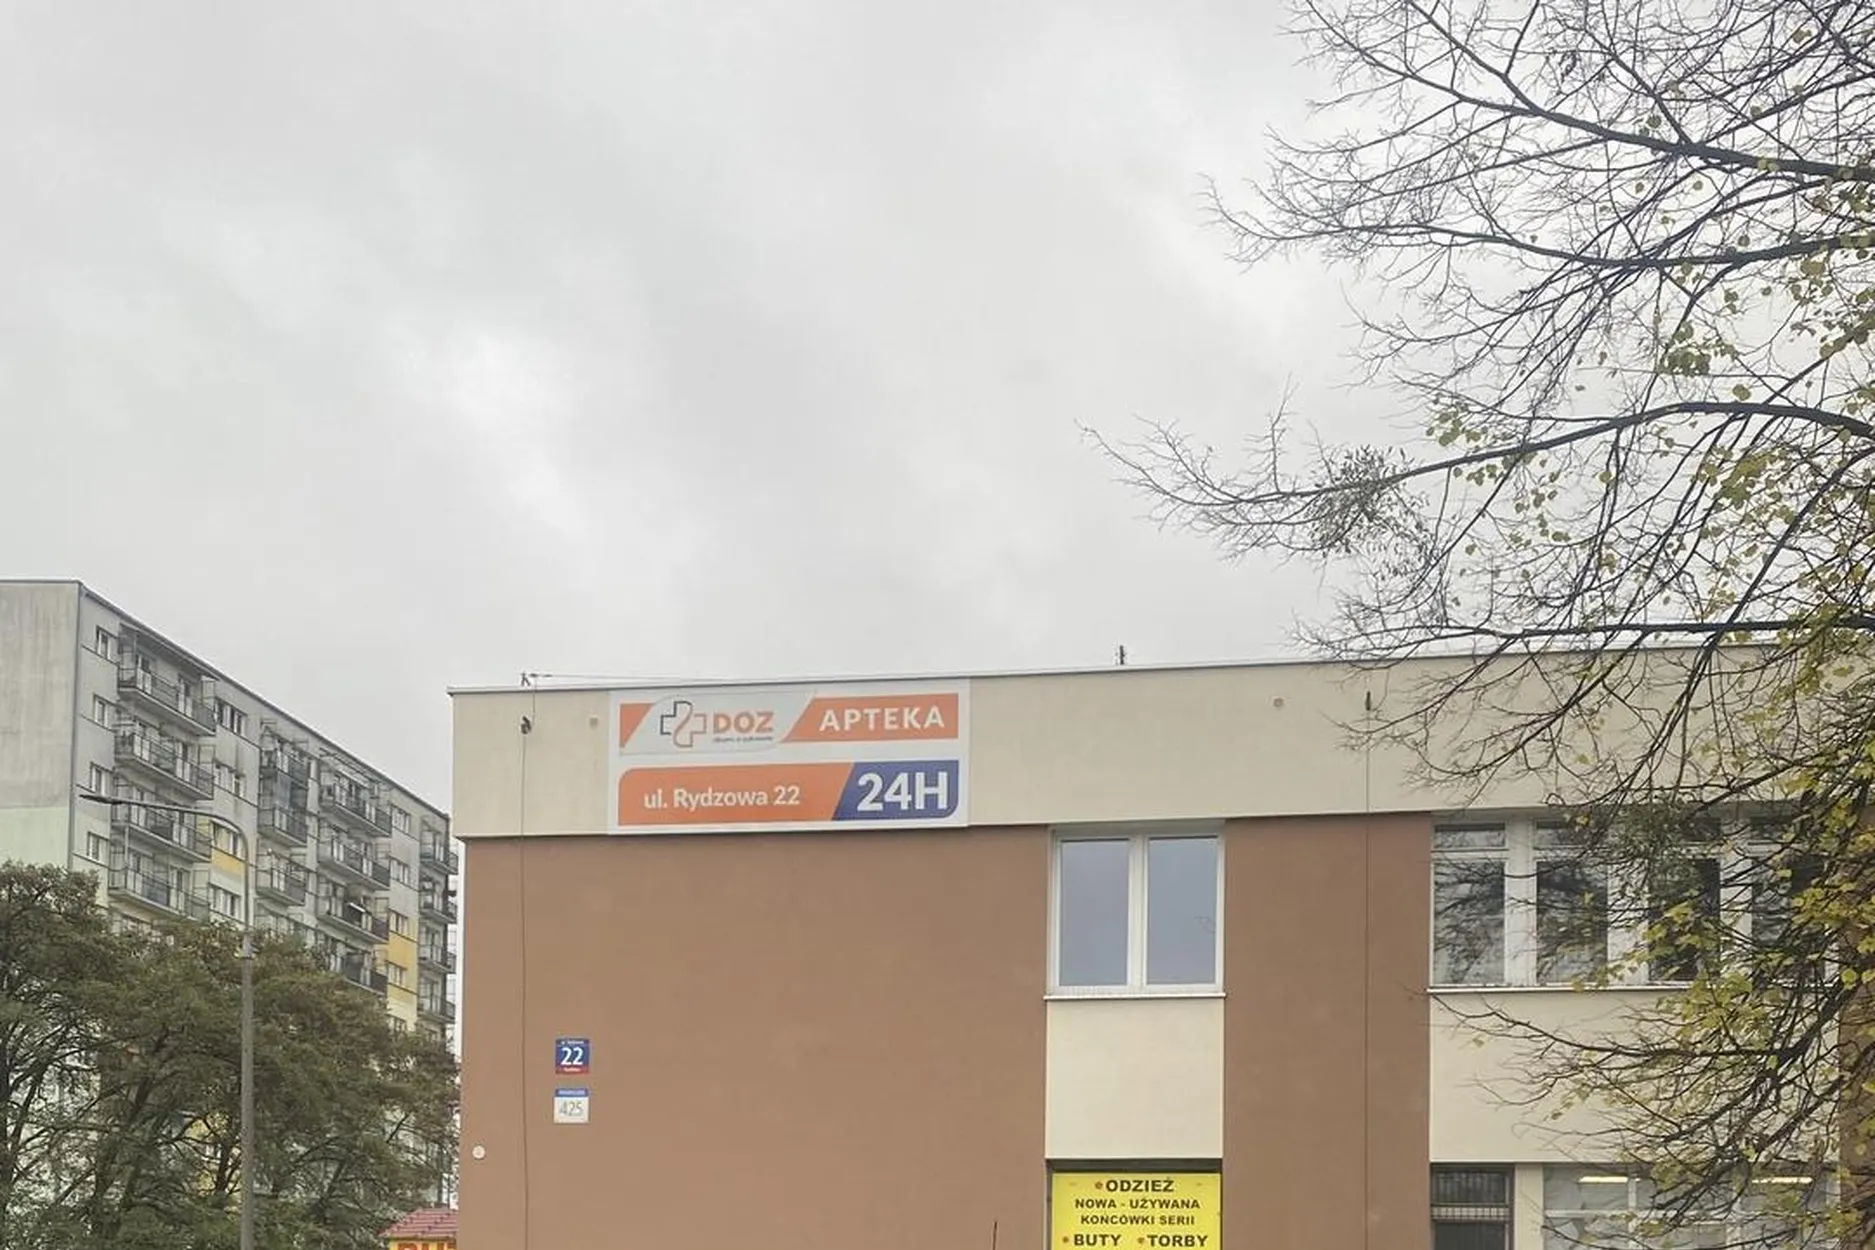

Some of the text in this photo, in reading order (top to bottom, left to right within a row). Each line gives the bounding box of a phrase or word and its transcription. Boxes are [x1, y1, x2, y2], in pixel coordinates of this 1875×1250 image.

[712, 711, 774, 735] DOZ
[819, 705, 945, 732] APTEKA
[644, 785, 800, 813] ul. Rydzowa 22
[856, 771, 948, 812] 24H
[560, 1046, 584, 1066] 22
[558, 1100, 584, 1117] 425
[1074, 1198, 1117, 1209] NOWA
[1159, 1214, 1195, 1226] SERII
[1073, 1233, 1208, 1248] BUTY TORBY
